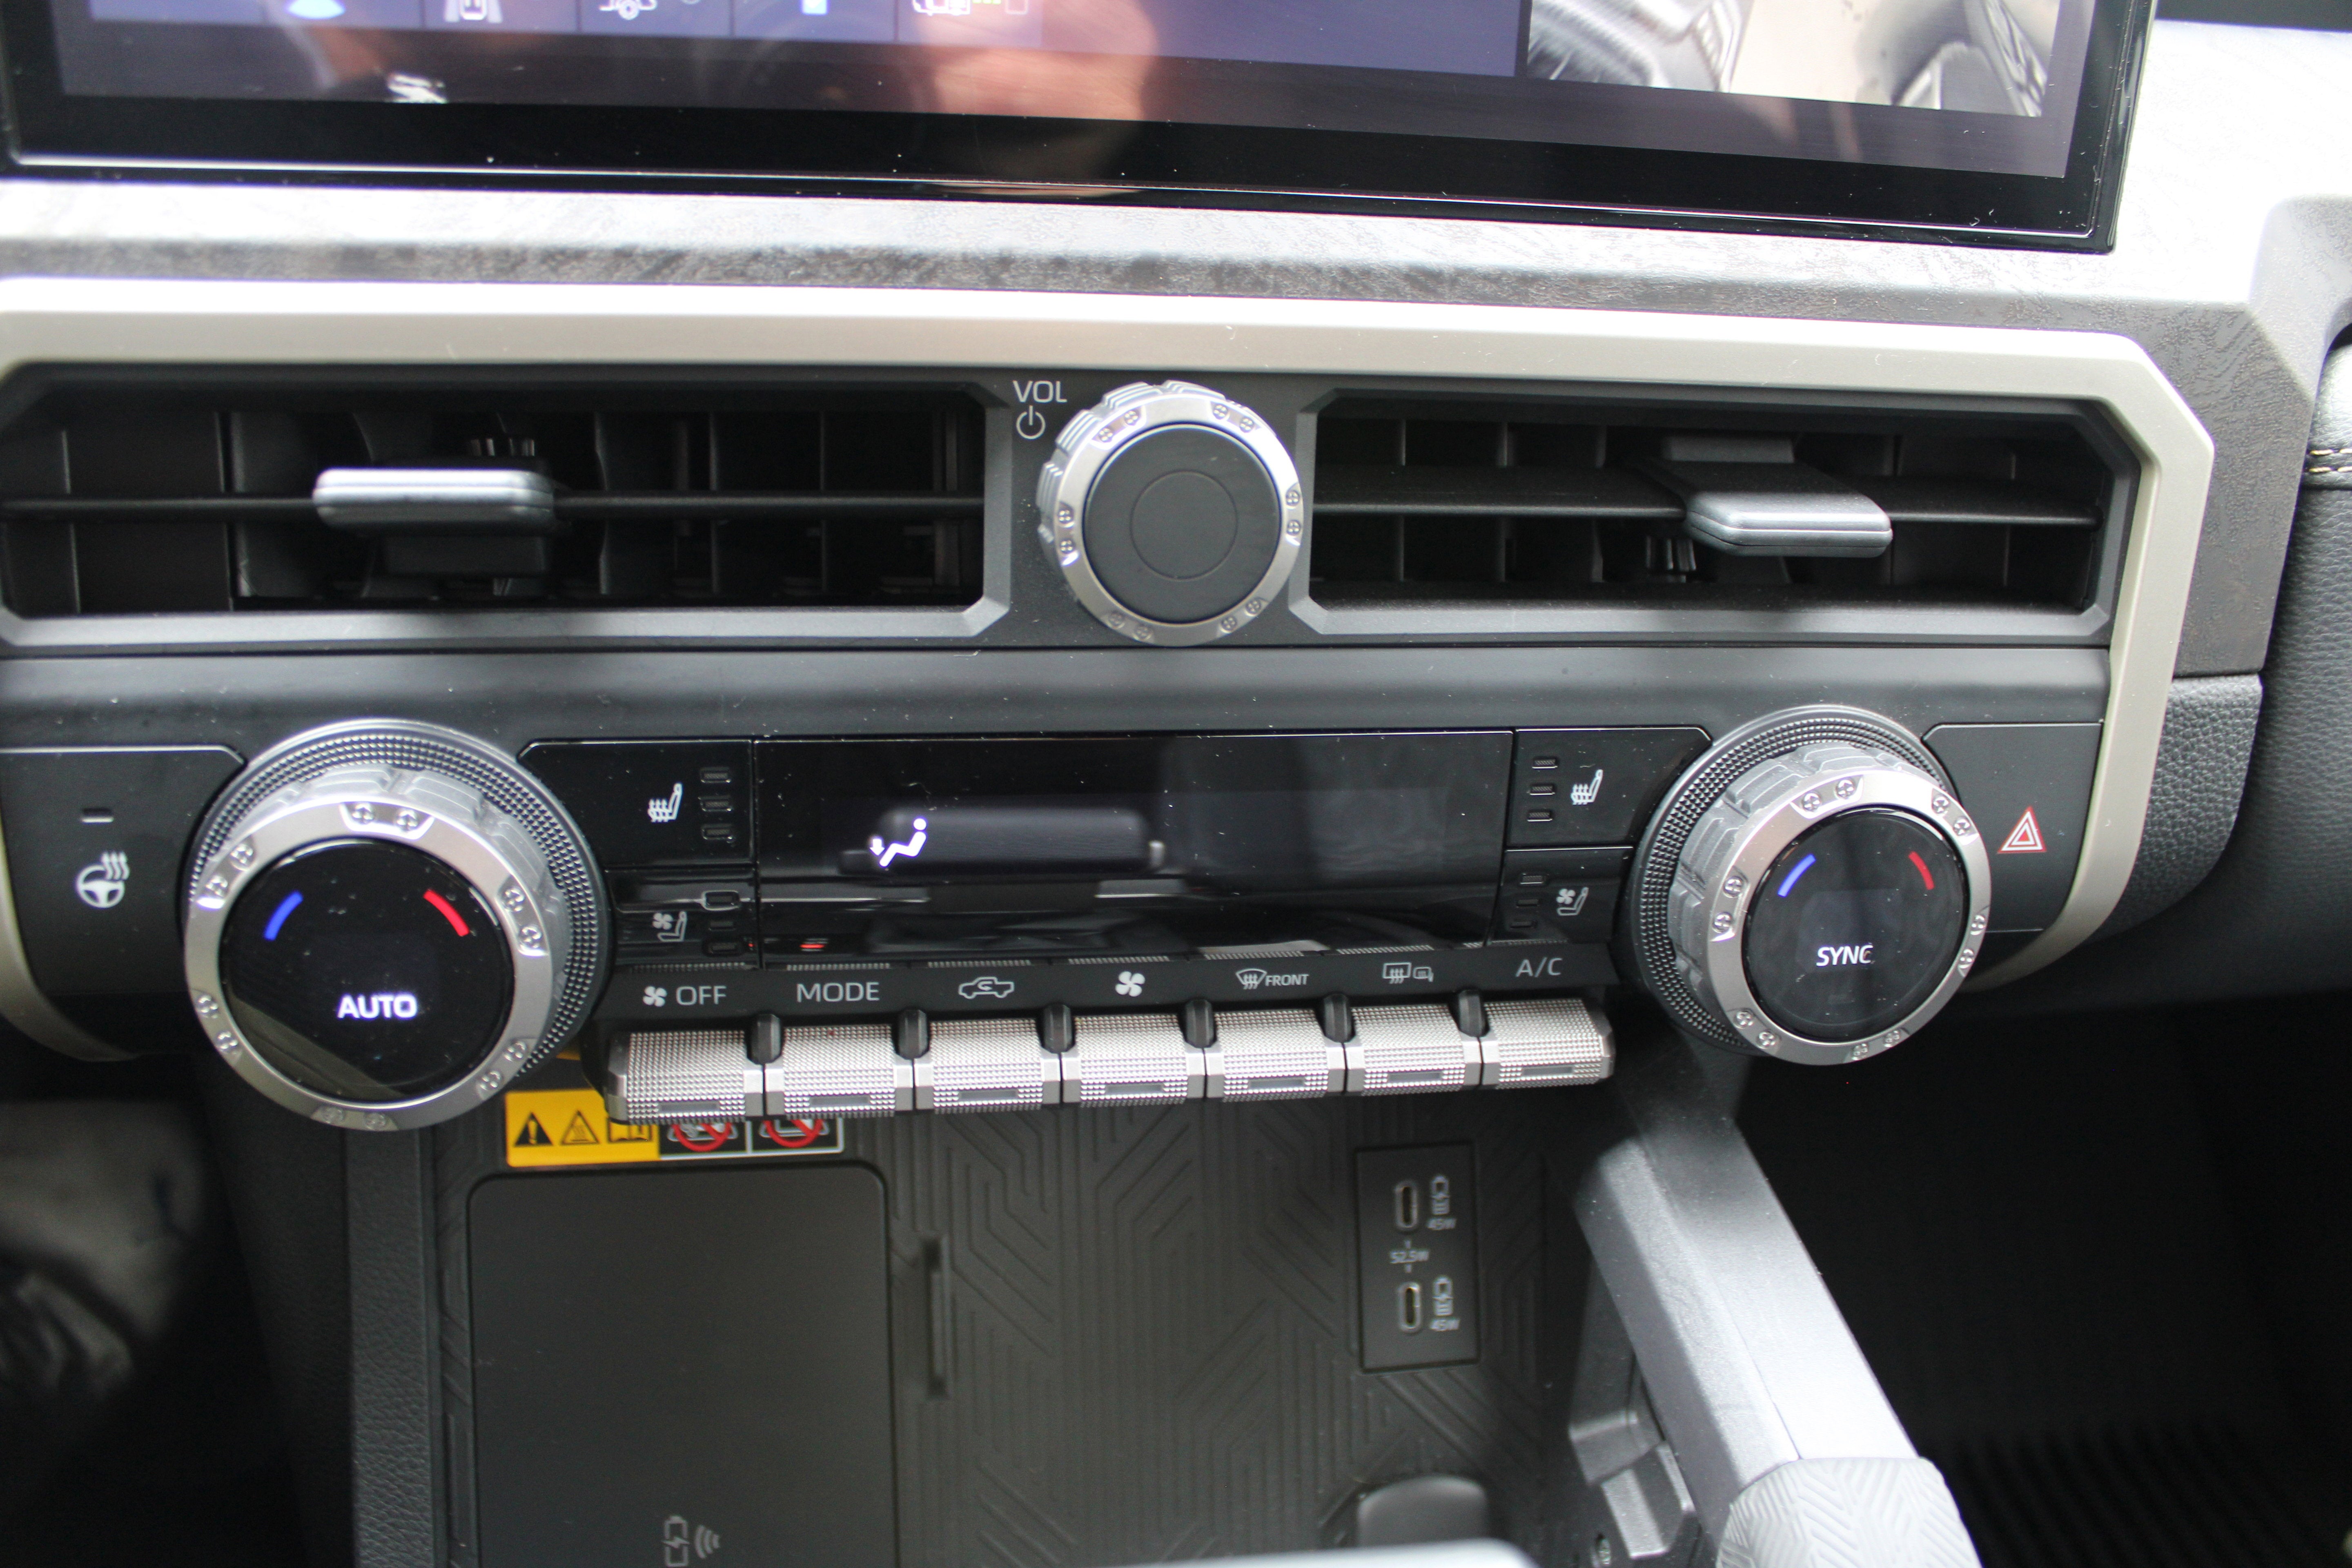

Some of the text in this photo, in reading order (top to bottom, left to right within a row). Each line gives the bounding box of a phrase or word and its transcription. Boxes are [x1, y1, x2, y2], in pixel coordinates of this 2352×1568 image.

[1013, 380, 1067, 403] VOL
[1816, 945, 1873, 967] SYNC
[1516, 958, 1563, 978] A/C
[1265, 974, 1309, 986] FRONT
[676, 986, 726, 1005] OFF
[797, 982, 880, 1002] MODE
[337, 994, 417, 1019] AUTO
